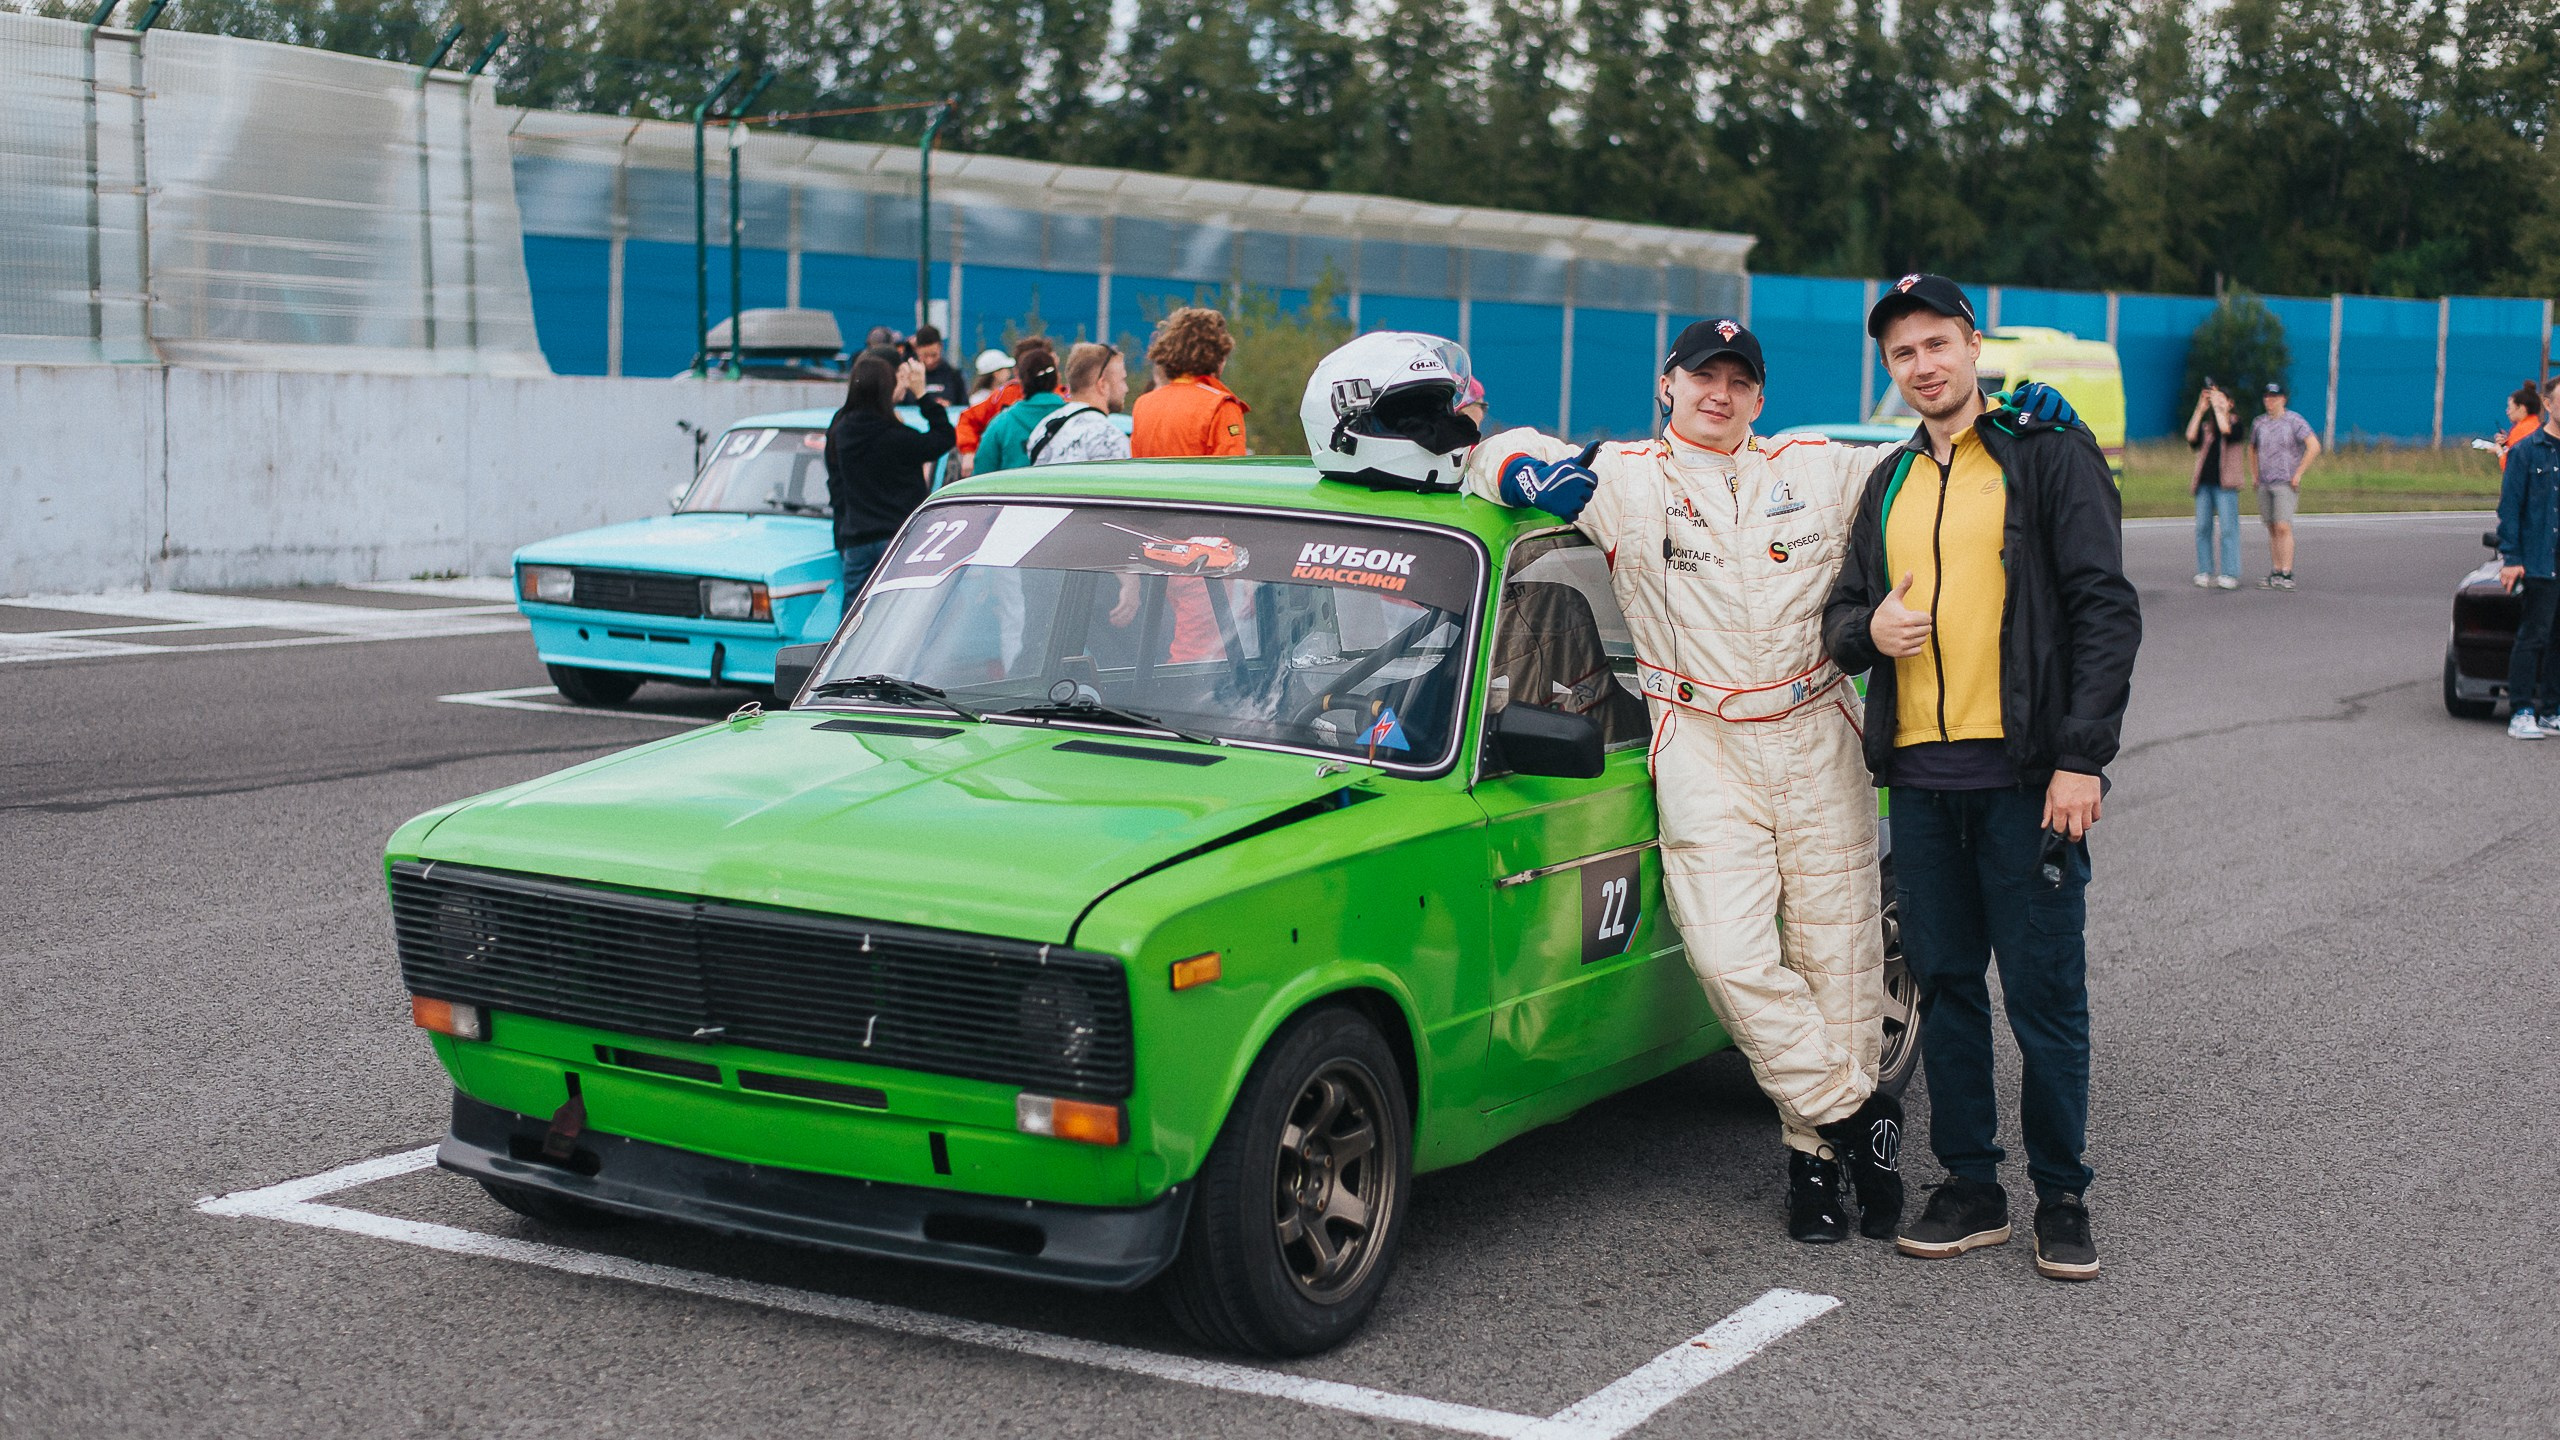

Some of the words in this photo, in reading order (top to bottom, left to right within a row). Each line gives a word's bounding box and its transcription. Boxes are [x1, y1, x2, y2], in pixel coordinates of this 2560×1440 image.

[1415, 360, 1440, 370] HJC
[904, 519, 968, 564] 22
[1298, 542, 1417, 575] КУБОК
[1667, 559, 1698, 573] TUBOS
[1713, 555, 1725, 568] DE
[1291, 565, 1407, 592] КЛАССИКИ
[1598, 877, 1628, 940] 22
